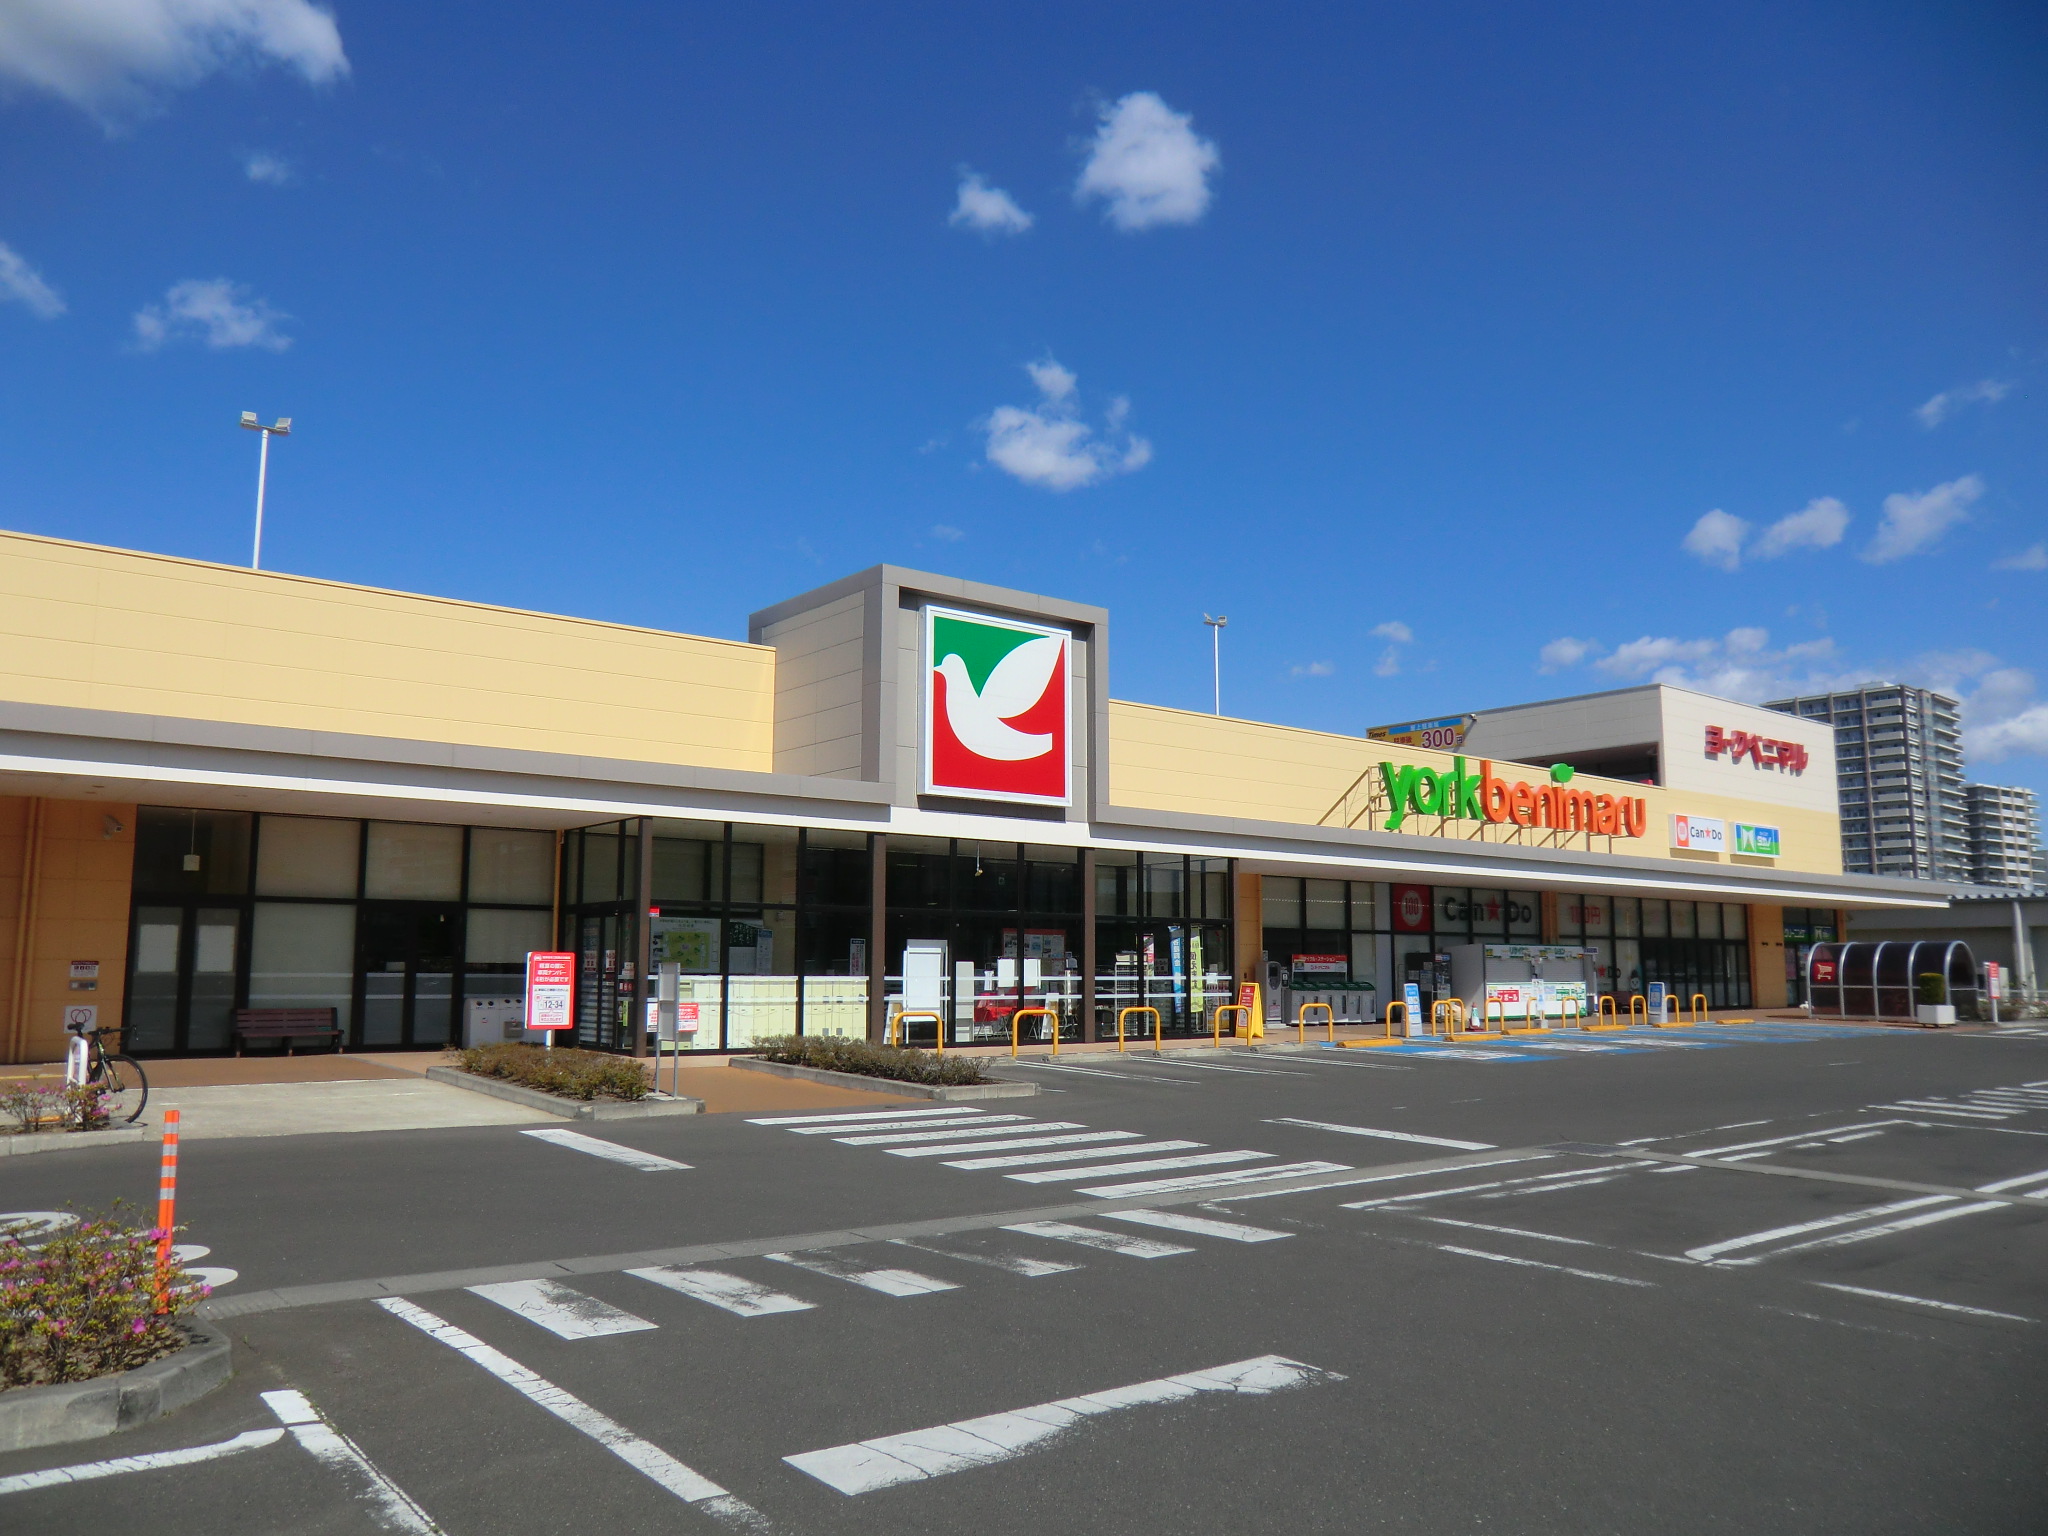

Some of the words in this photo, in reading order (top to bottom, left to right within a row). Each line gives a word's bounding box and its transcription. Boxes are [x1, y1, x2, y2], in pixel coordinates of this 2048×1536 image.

[1421, 728, 1454, 749] 300
[1704, 725, 1809, 771] ヨークベニマル
[1690, 826, 1705, 838] Can
[1711, 829, 1722, 840] Do
[1443, 896, 1484, 922] Can
[1508, 900, 1532, 923] Do
